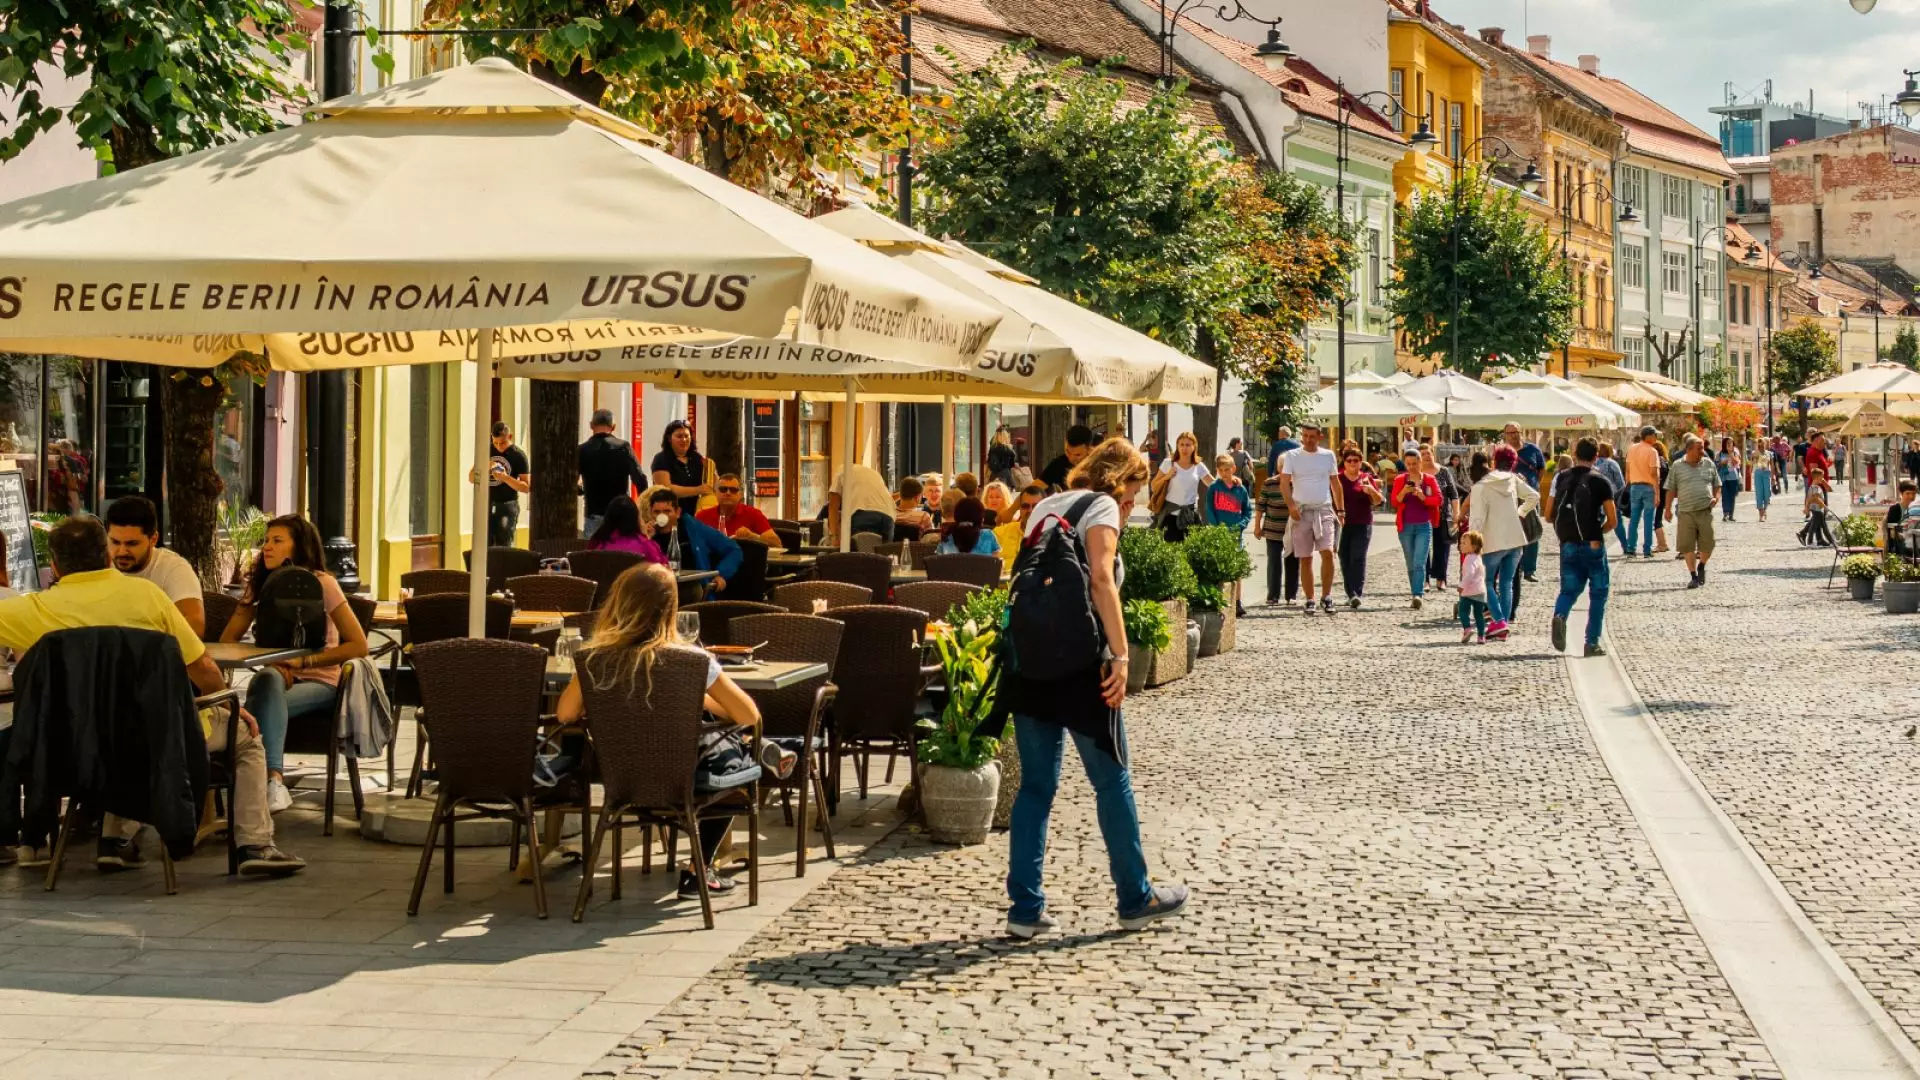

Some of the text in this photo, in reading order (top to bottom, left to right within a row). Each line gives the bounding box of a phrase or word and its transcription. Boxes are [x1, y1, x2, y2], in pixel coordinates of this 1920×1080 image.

[54, 283, 190, 312] REGELE
[202, 284, 300, 310] BERII
[314, 275, 355, 311] ÎN
[368, 275, 549, 311] ROMÂNIA
[581, 270, 750, 312] URSUS
[804, 281, 849, 331] URSUS
[851, 300, 885, 335] REGELE
[621, 345, 701, 359] REGELE
[711, 346, 769, 360] BERII
[778, 342, 801, 362] ÎN
